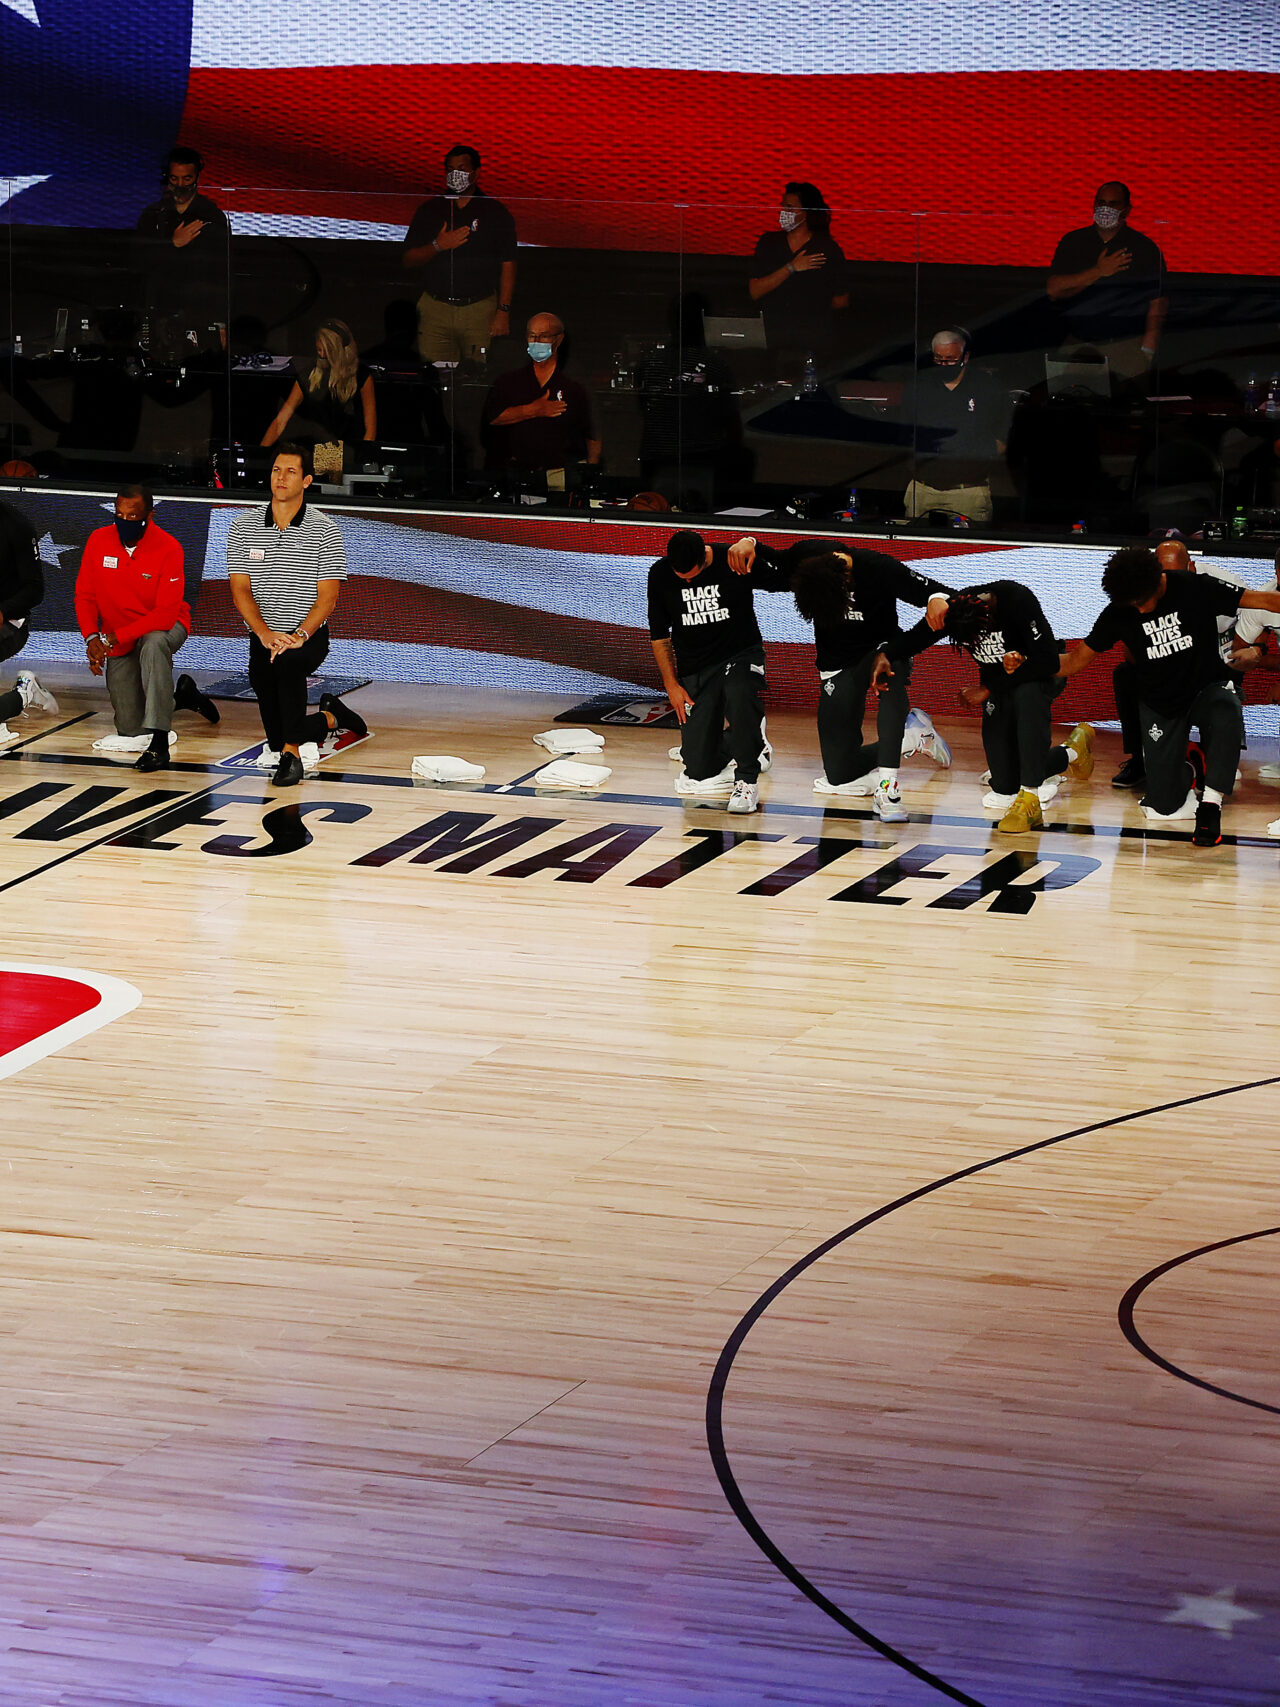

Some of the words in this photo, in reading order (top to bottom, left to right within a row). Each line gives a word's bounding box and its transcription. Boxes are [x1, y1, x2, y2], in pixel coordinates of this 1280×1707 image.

[681, 584, 721, 602] BLACK
[681, 607, 731, 626] MATTER
[686, 598, 720, 614] LIVES
[1141, 611, 1182, 636] BLACK
[1146, 634, 1194, 660] MATTER
[1149, 625, 1182, 647] LIVES
[349, 810, 1104, 915] MATTER
